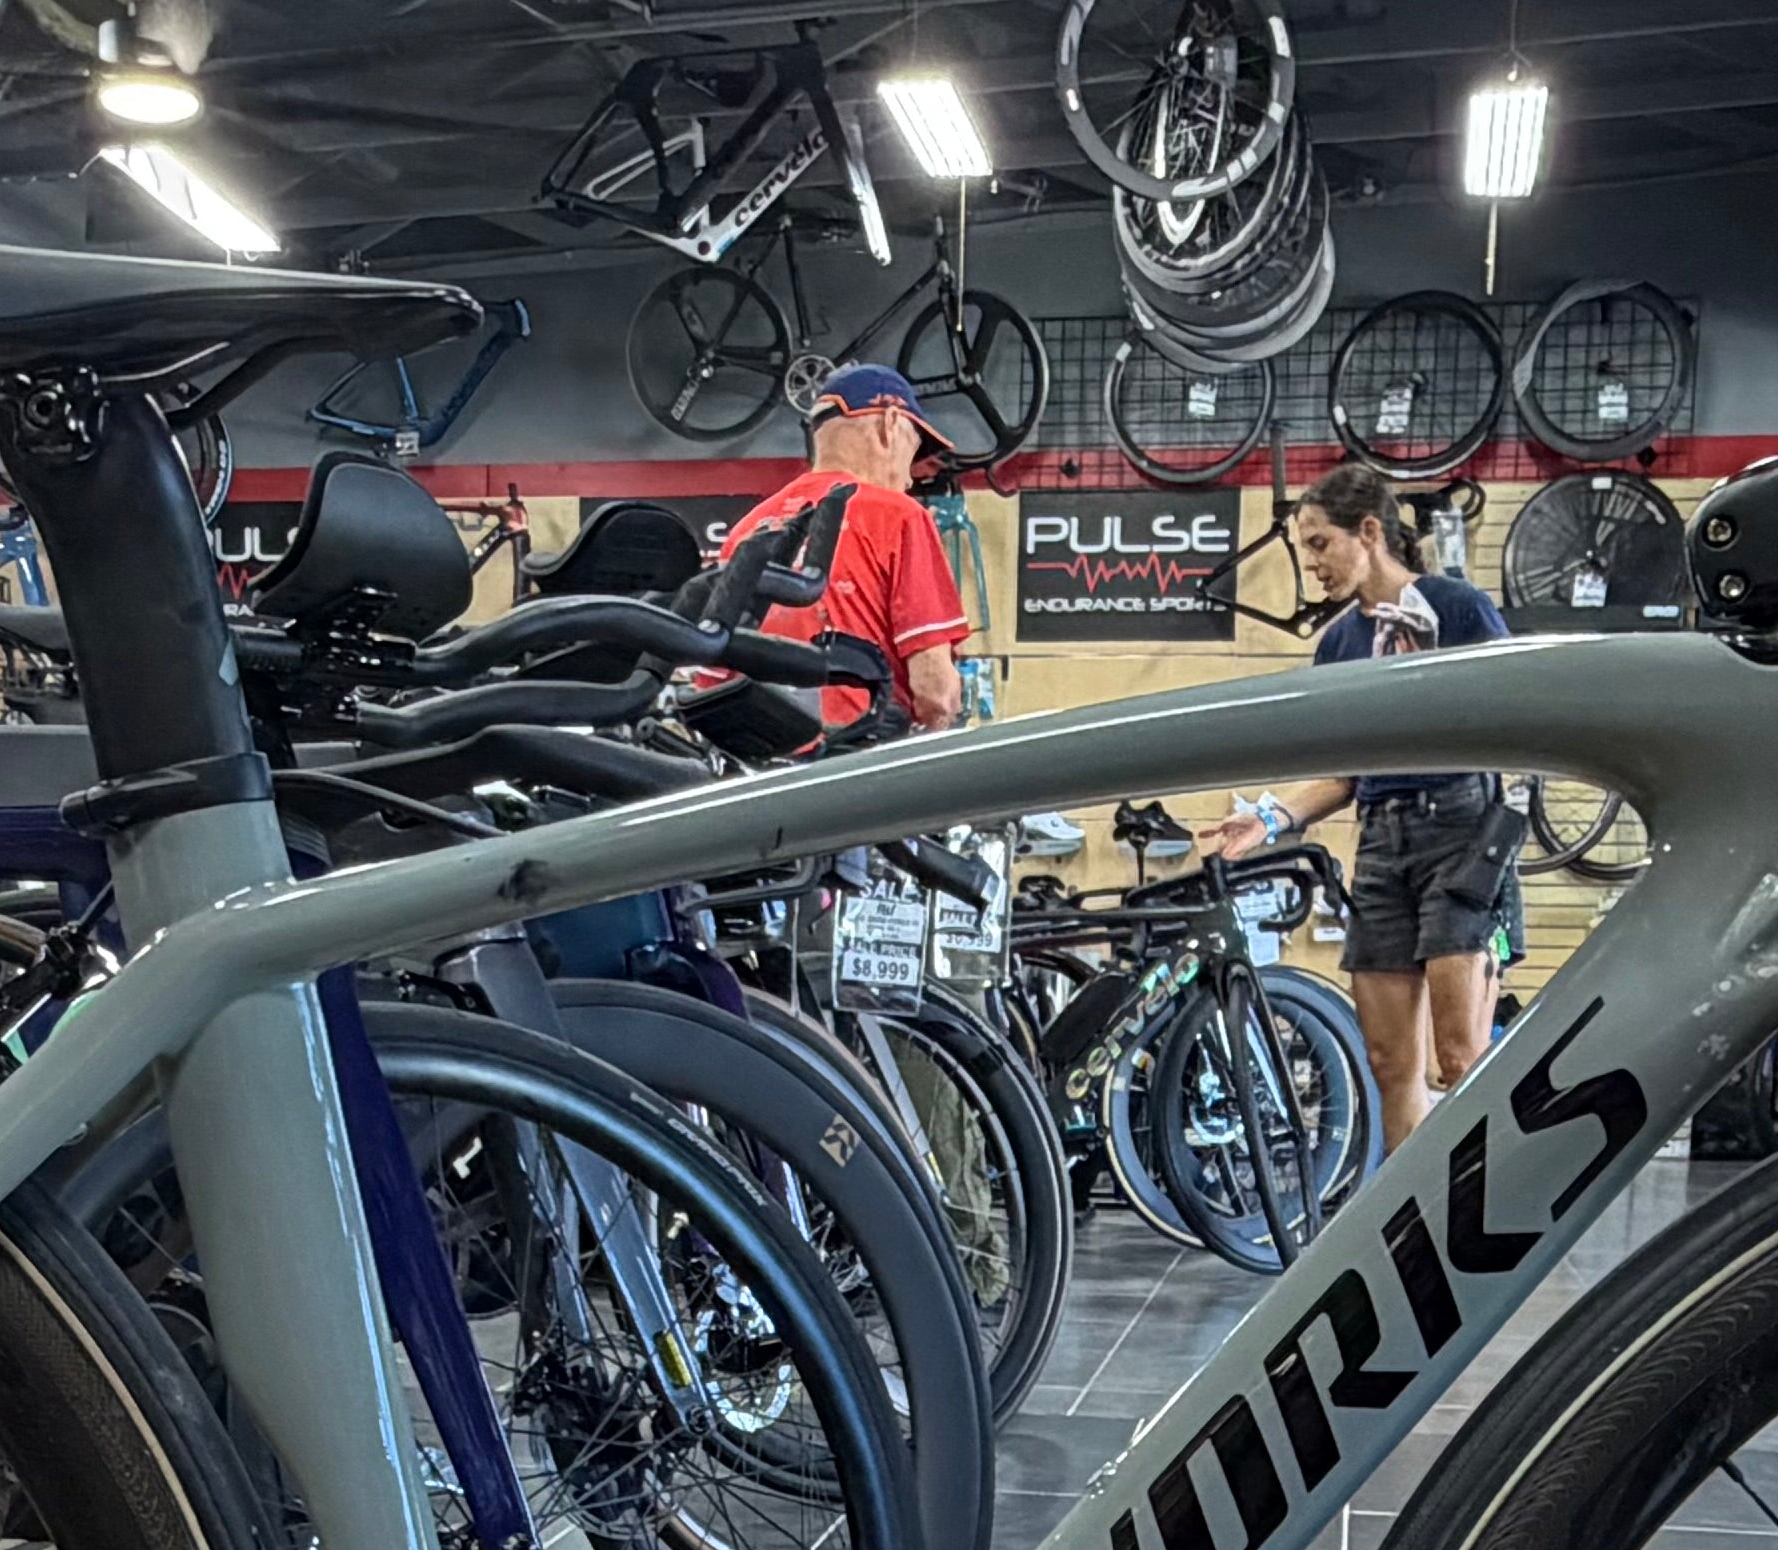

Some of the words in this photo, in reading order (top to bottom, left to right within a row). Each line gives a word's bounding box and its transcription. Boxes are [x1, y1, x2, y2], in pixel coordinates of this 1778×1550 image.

[206, 526, 301, 562] UL
[1026, 514, 1231, 554] PULSE
[1024, 597, 1146, 613] ENDURANCE
[859, 878, 914, 903] SALE
[852, 958, 910, 981] $8,999
